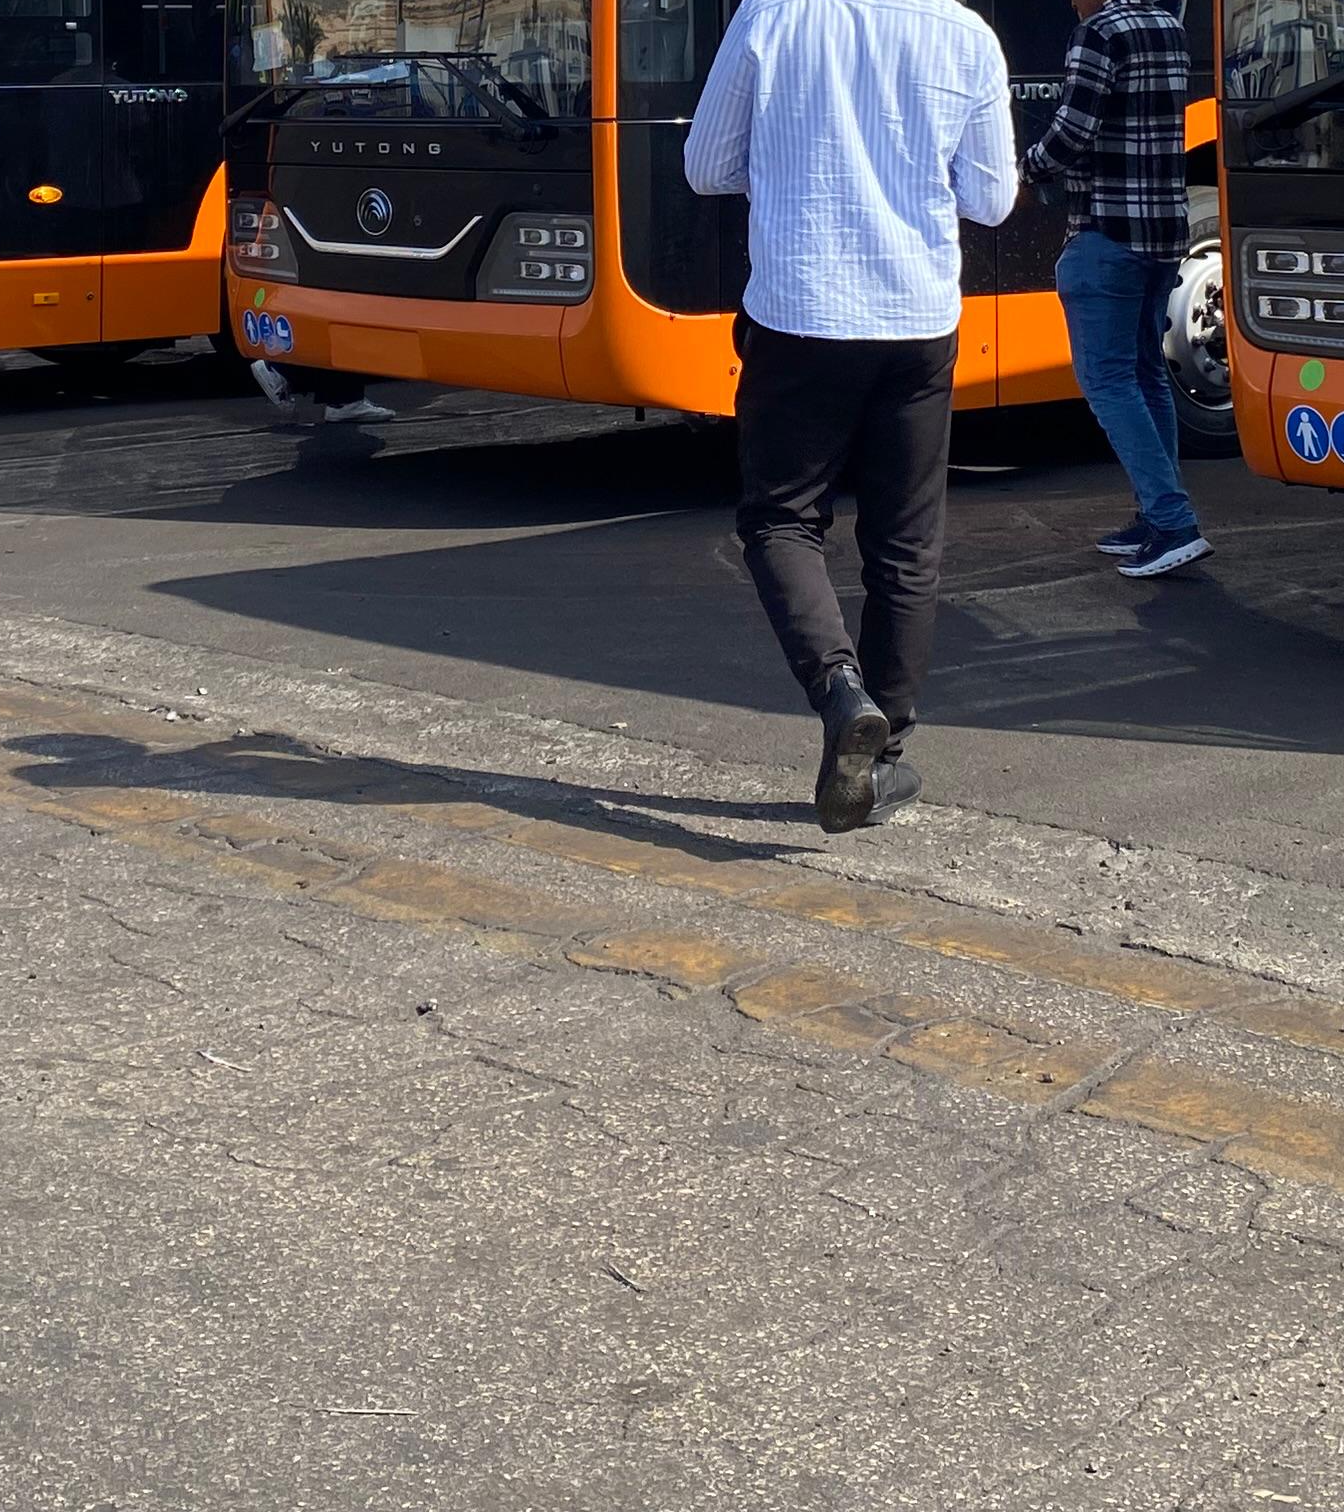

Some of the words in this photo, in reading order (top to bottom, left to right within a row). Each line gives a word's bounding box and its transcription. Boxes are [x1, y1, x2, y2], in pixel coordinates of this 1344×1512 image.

[108, 88, 188, 104] YUTONG
[1010, 82, 1065, 100] UTON
[310, 140, 442, 155] YUTONG
